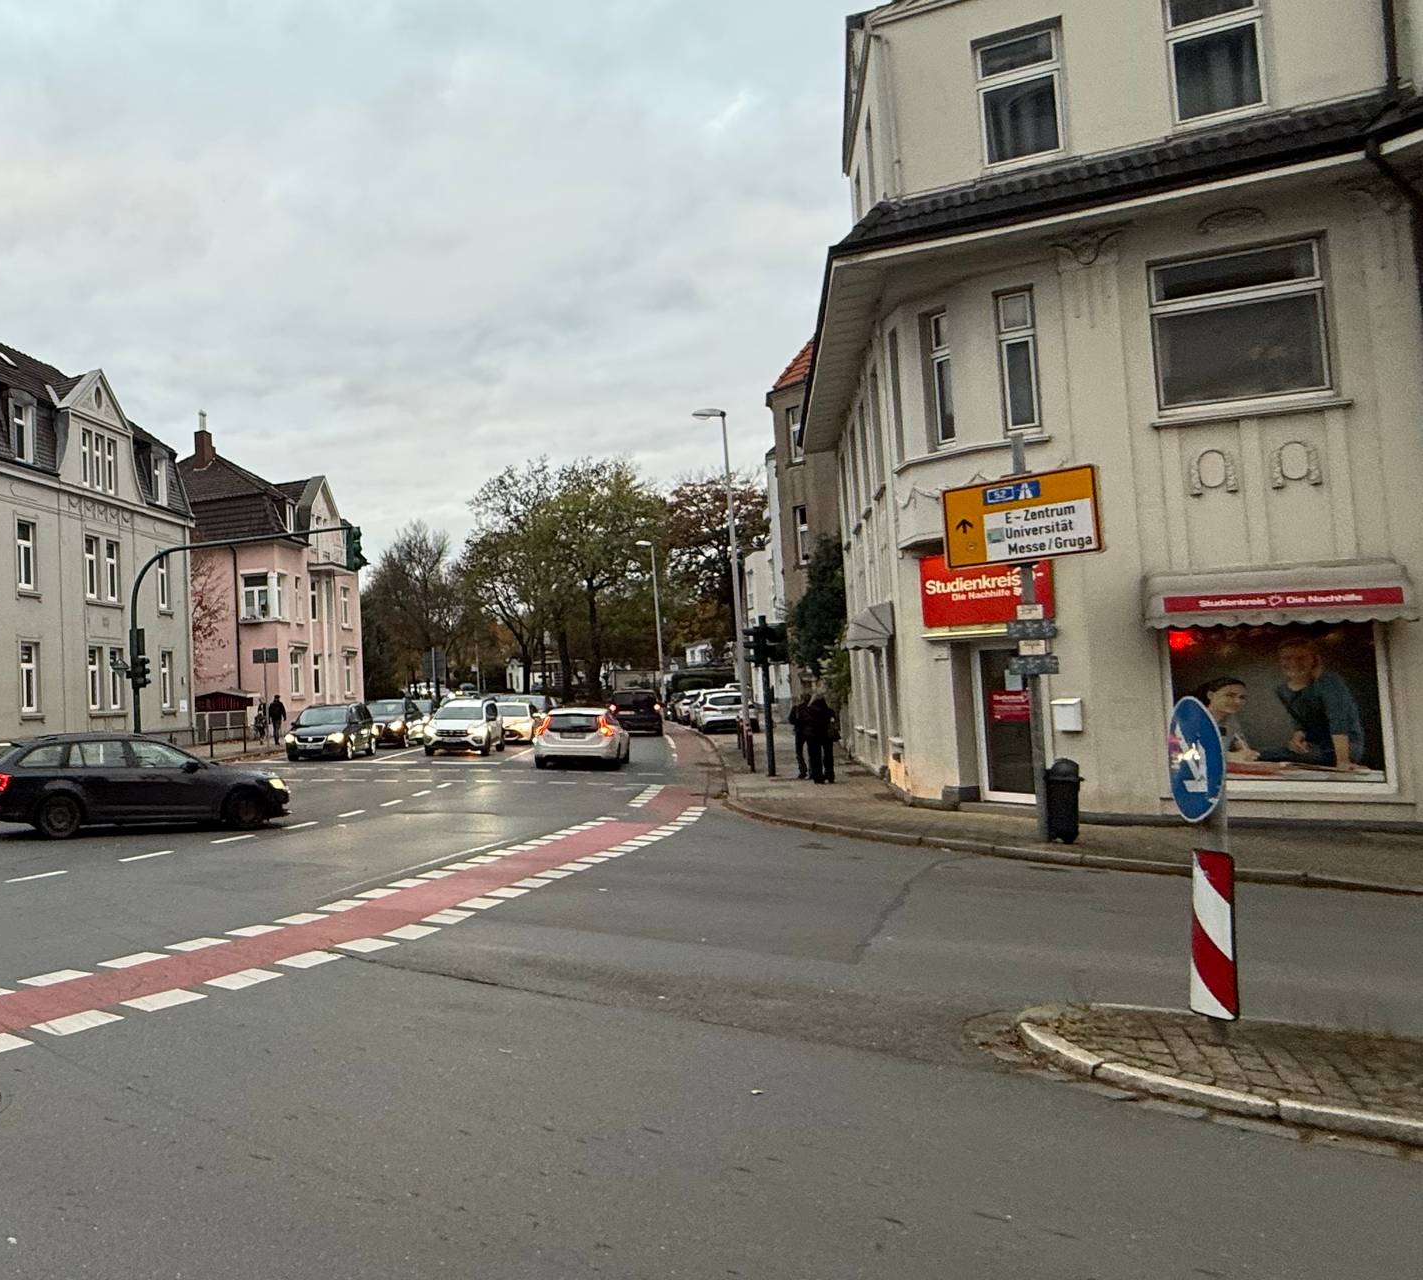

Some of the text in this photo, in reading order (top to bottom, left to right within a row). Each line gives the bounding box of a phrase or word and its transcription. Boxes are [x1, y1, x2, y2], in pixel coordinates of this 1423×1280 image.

[1005, 519, 1074, 540] Universität
[925, 571, 1022, 595] Studienkreis
[951, 588, 1011, 602] Die Nachhilfe
[1286, 592, 1363, 605] Die Nachhilfe
[1198, 597, 1267, 609] Studienkreis
